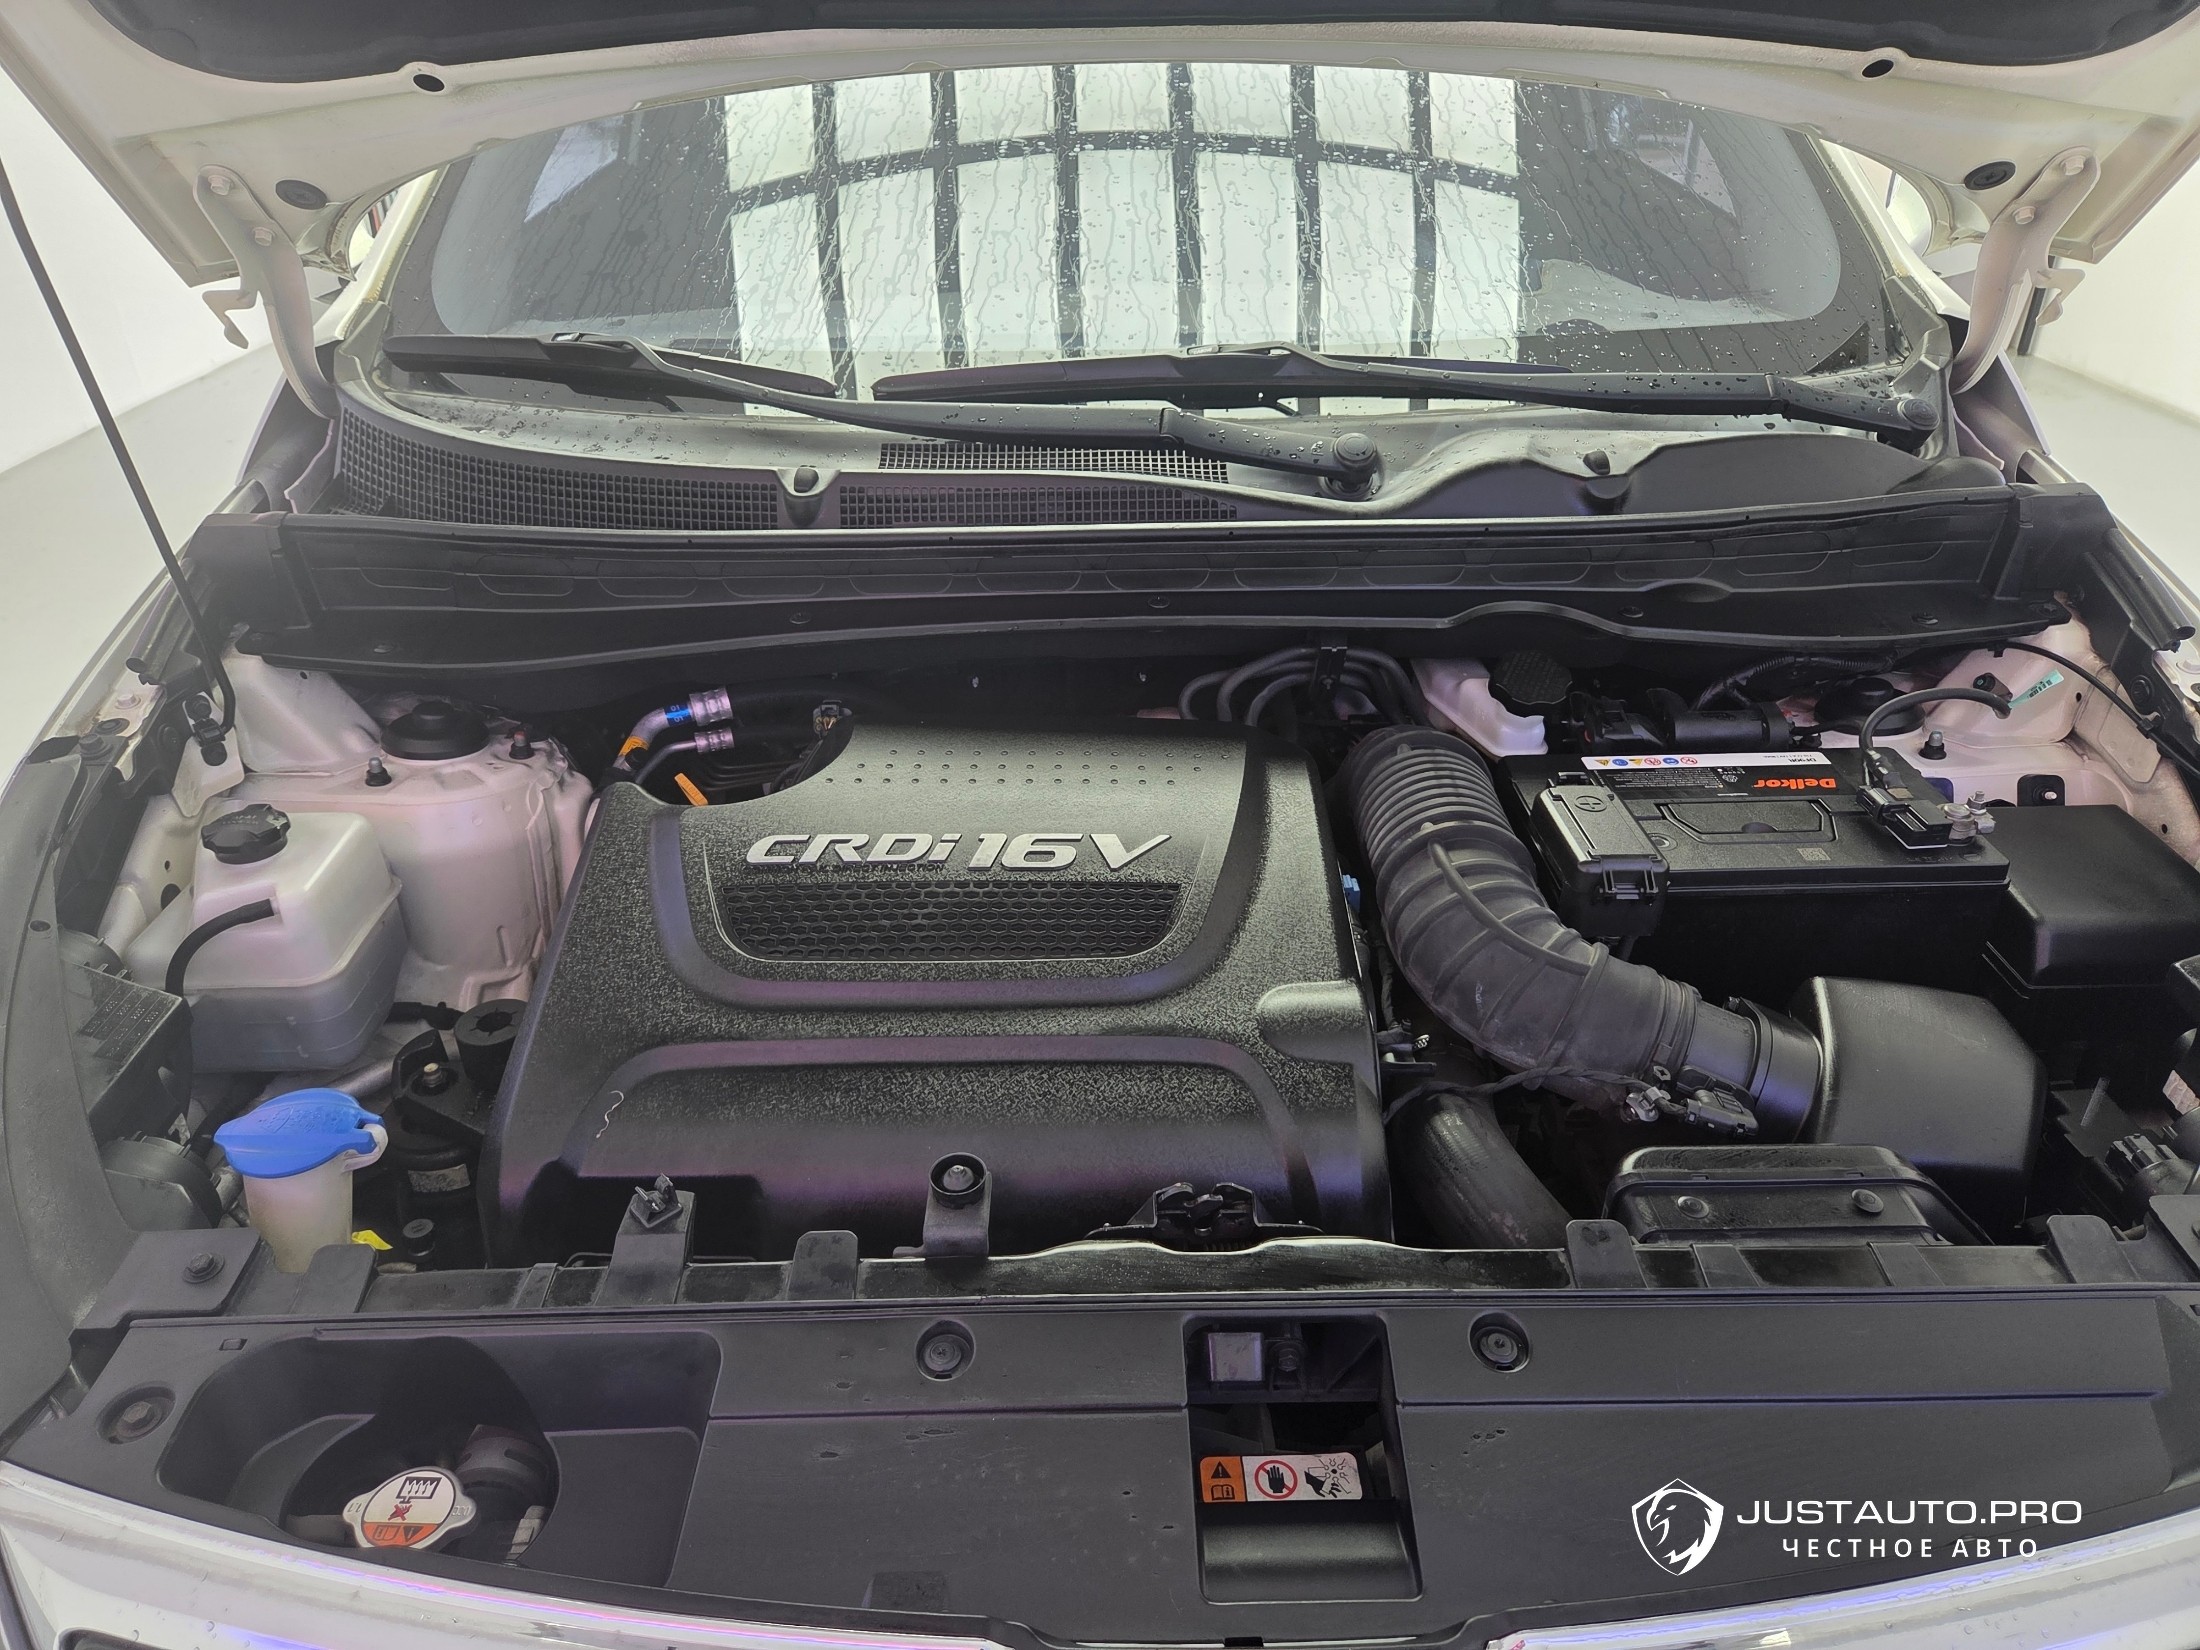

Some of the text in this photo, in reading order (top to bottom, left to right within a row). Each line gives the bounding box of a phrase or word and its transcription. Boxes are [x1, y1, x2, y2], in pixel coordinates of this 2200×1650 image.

[1753, 778, 1837, 790] Delkor
[746, 833, 1172, 872] CRDi 16V
